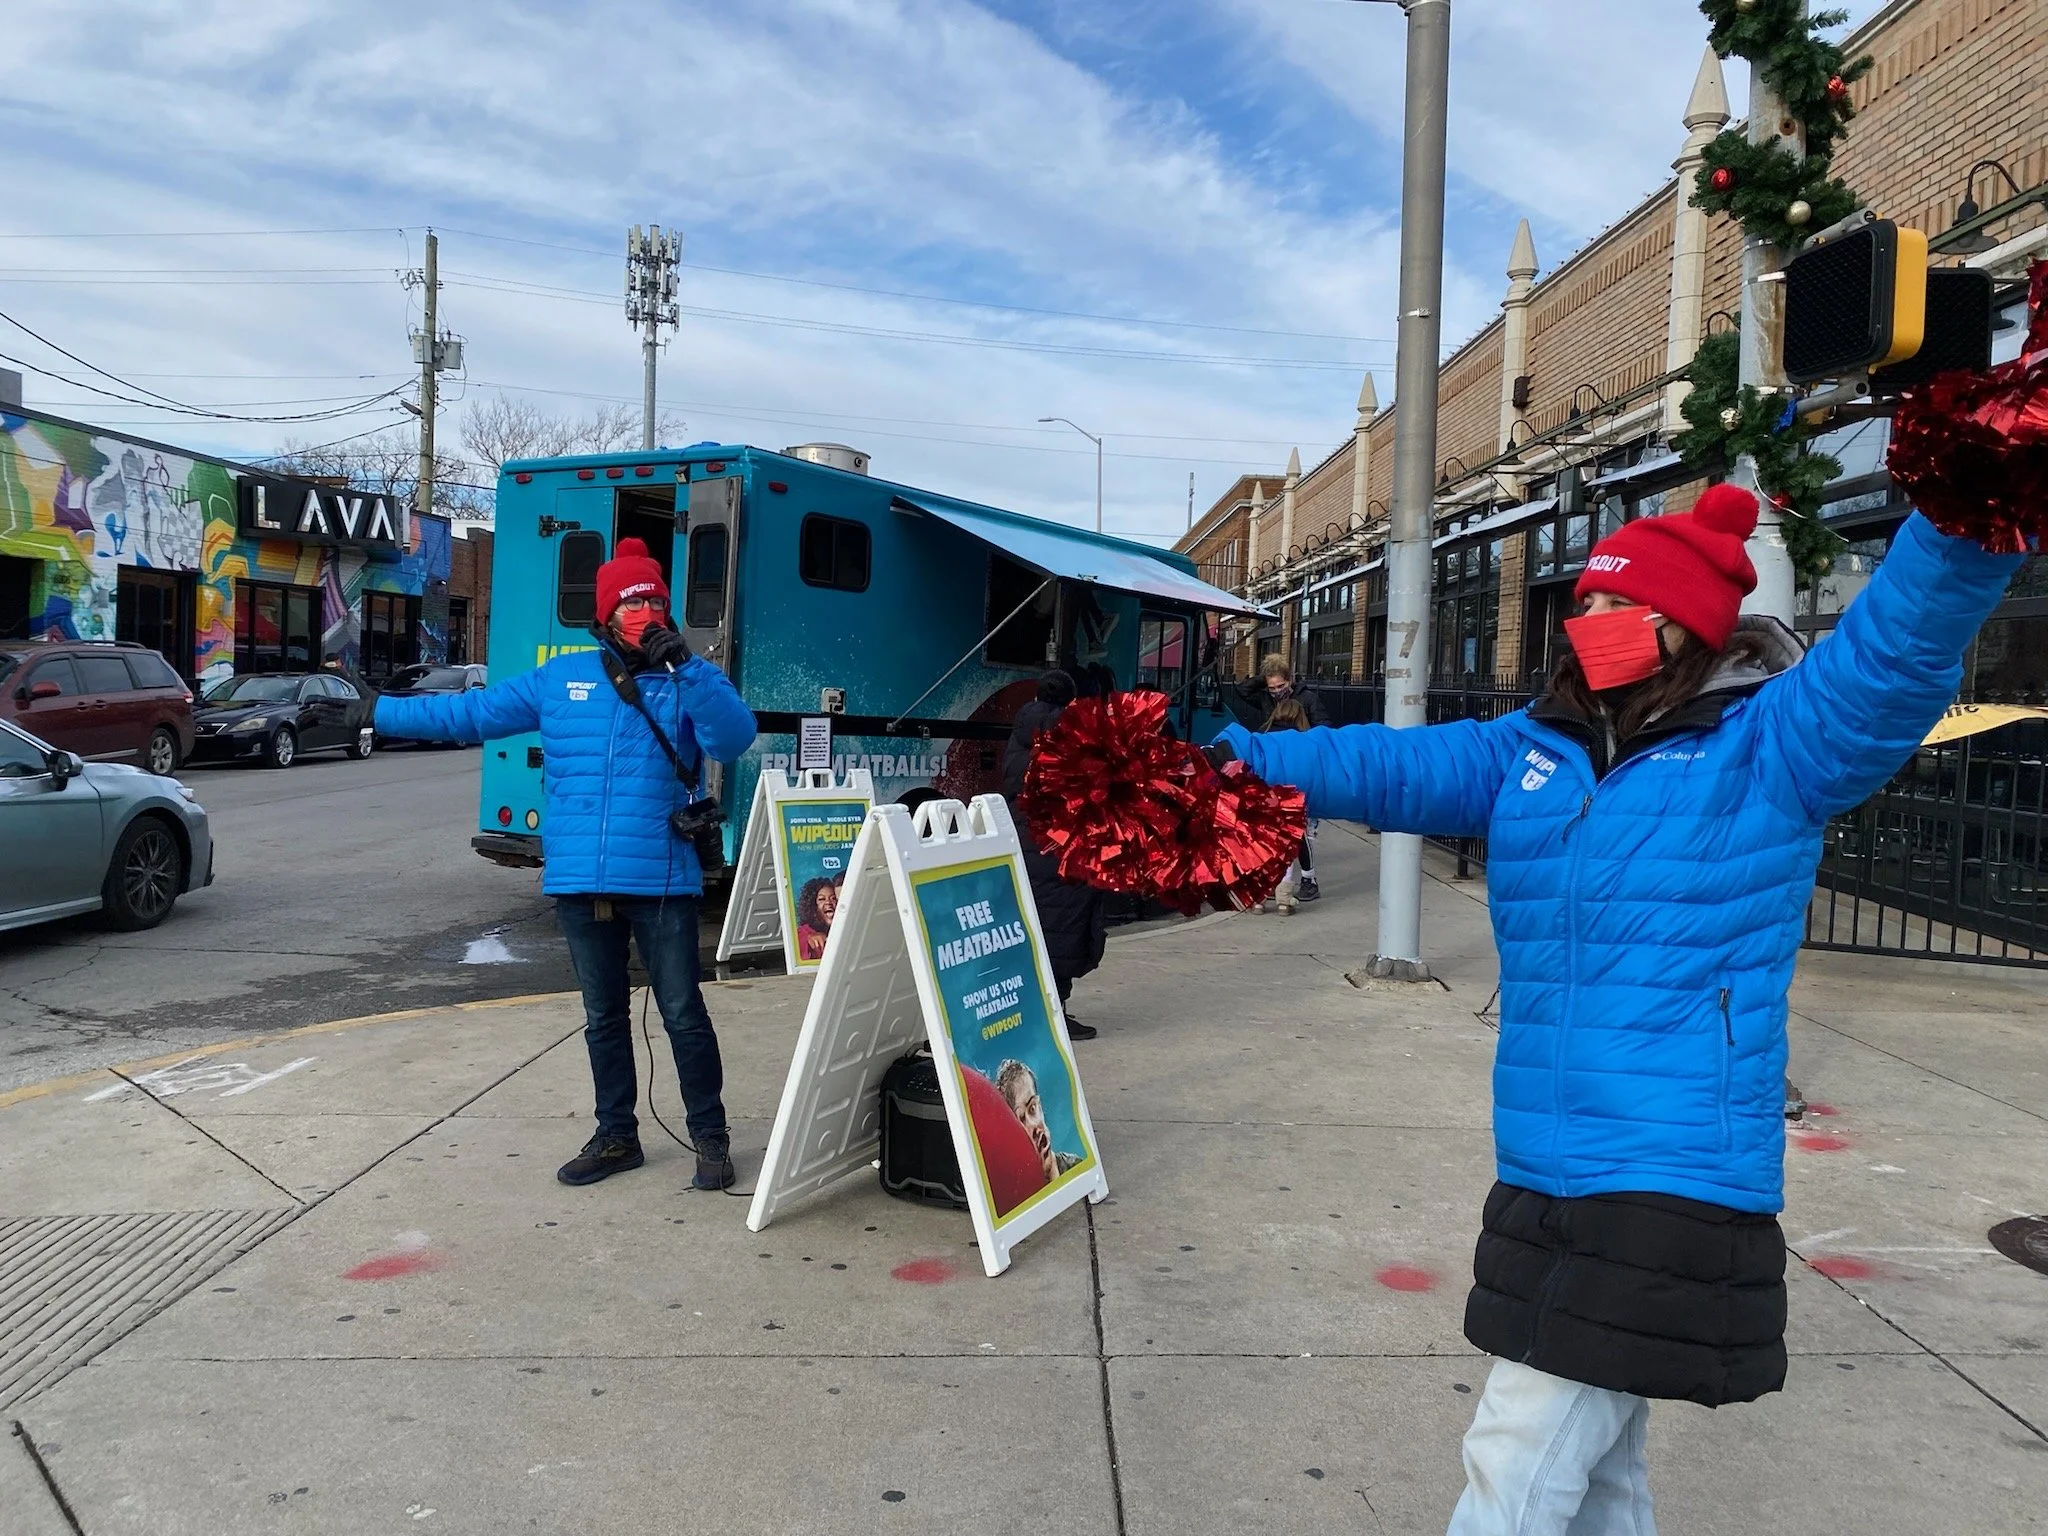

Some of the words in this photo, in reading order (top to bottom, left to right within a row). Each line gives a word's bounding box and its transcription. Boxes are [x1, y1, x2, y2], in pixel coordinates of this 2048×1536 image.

[253, 485, 396, 541] LAVA
[619, 582, 656, 599] WIPEOUT
[566, 681, 598, 690] WIPEOUT
[832, 754, 948, 777] MEATBALLS!
[790, 824, 862, 843] WIPEOUT
[824, 858, 839, 867] tbs
[955, 900, 994, 931] FREE
[937, 921, 1026, 971] MEATBALLS
[962, 988, 989, 1009] SHOW
[988, 983, 1001, 998] US
[1000, 975, 1024, 993] YOUR
[976, 992, 1019, 1020] MEATBALLS
[981, 1012, 1023, 1041] @WIPEOUT
